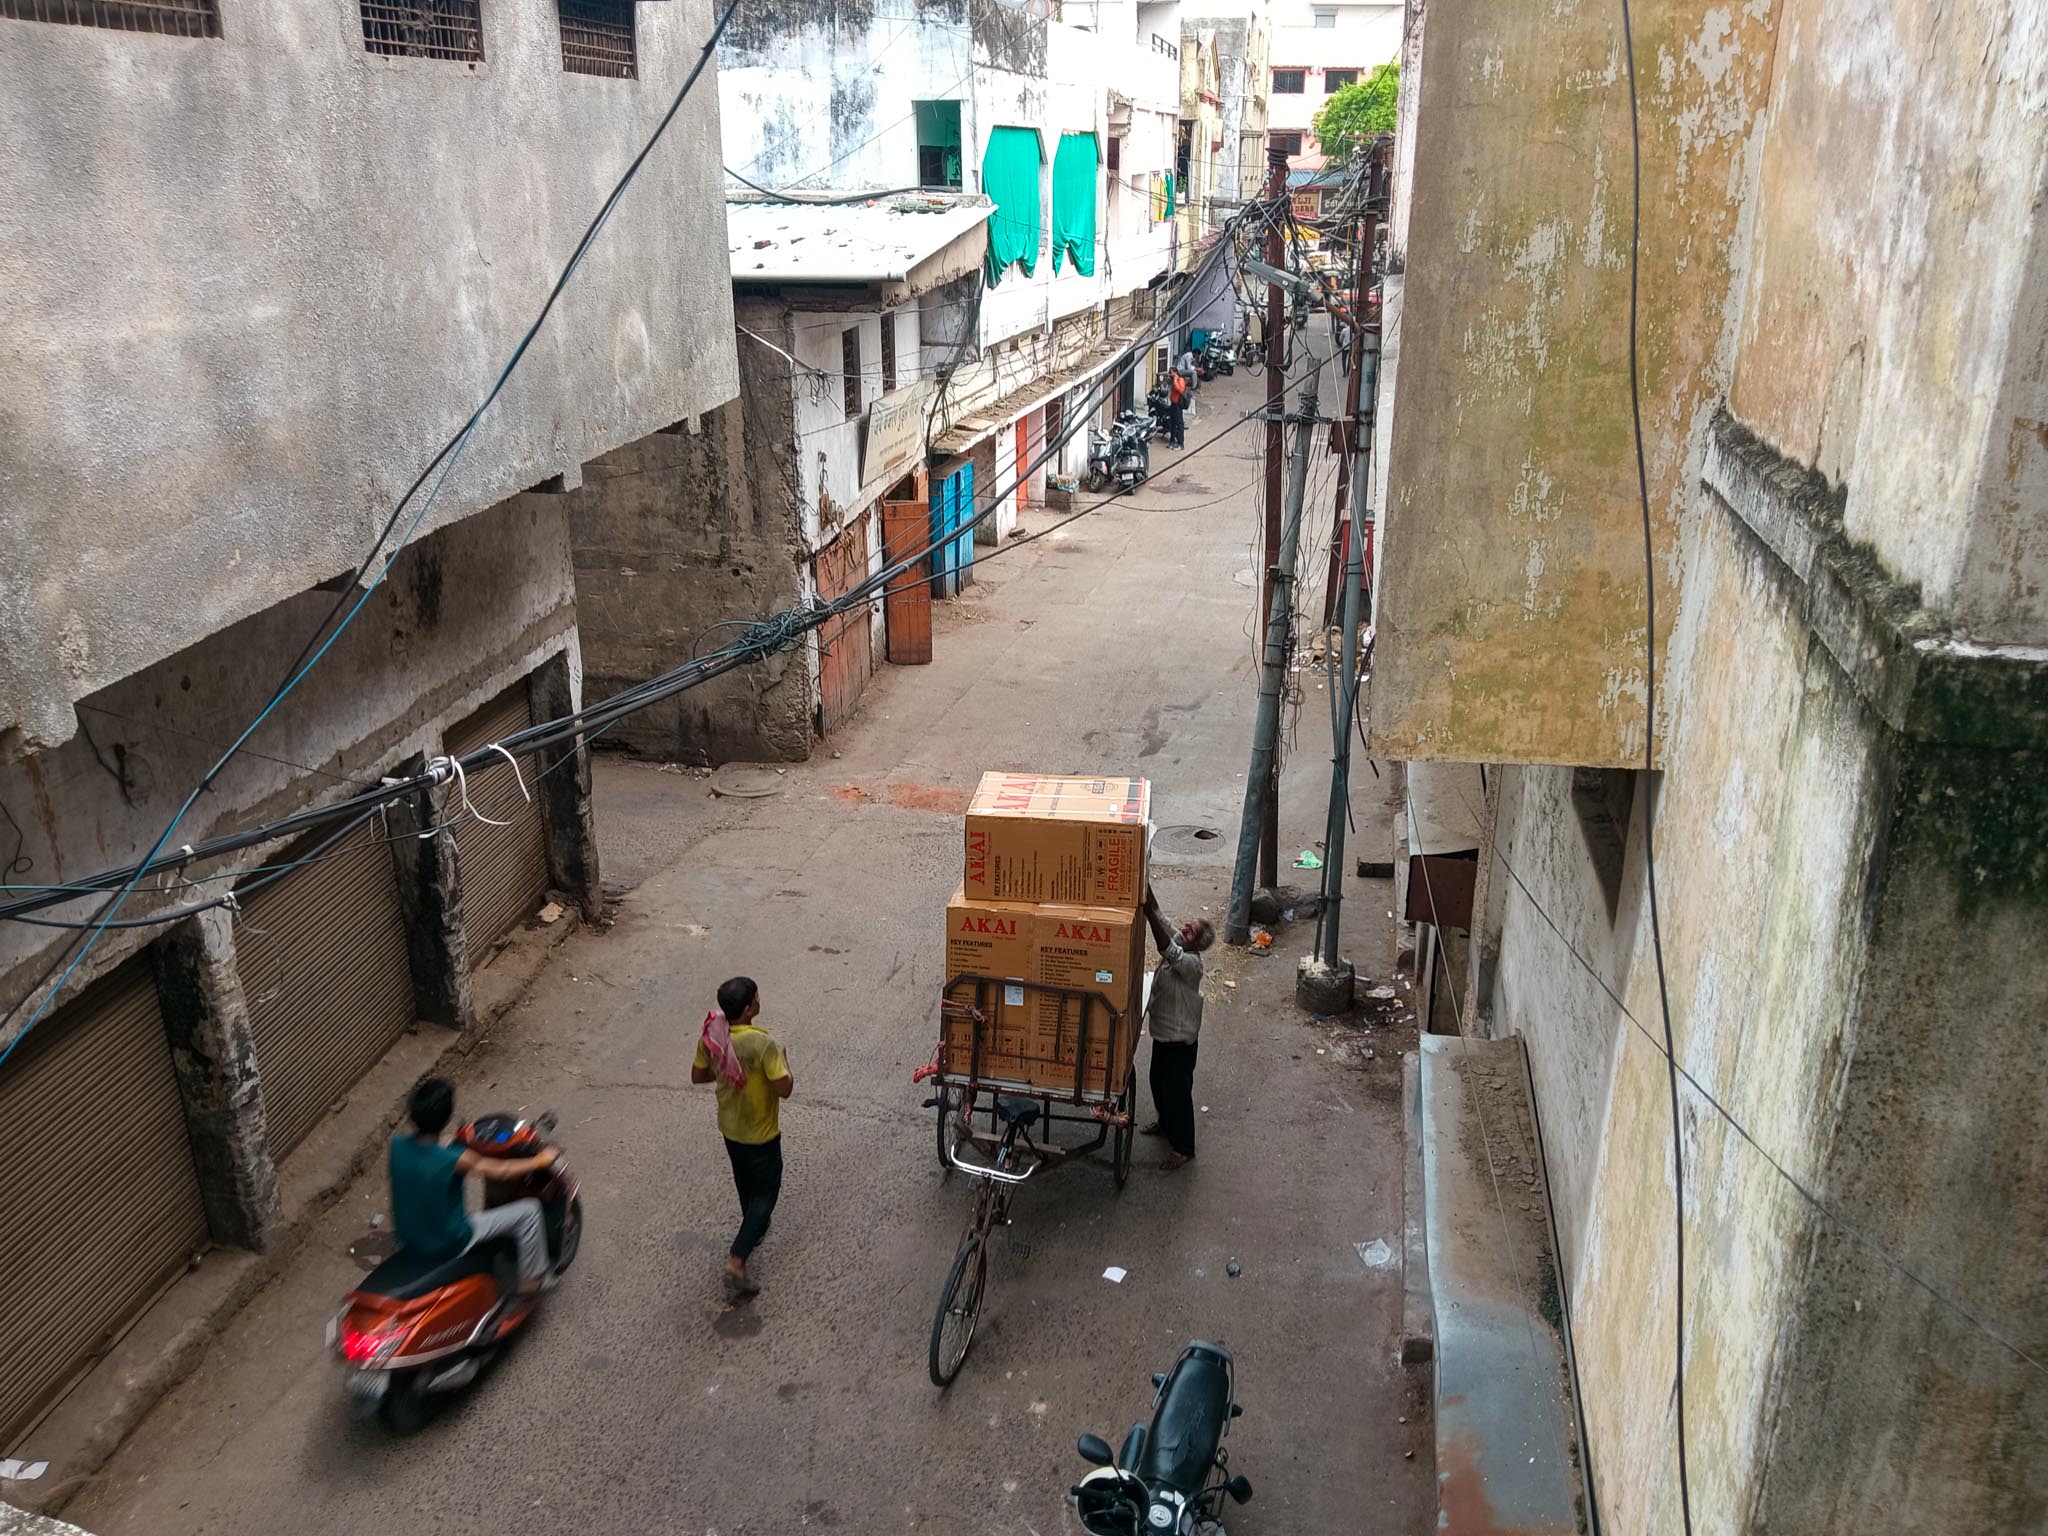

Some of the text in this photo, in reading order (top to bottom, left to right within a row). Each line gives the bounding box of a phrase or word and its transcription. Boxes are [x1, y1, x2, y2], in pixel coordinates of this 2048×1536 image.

[969, 831, 985, 886] AKAI
[1108, 838, 1120, 891] FRAGILE
[960, 915, 1017, 935] AKAI
[1054, 922, 1111, 943] AKAI
[950, 938, 993, 949] KEY FEATURES
[1054, 947, 1088, 957] FEATURES
